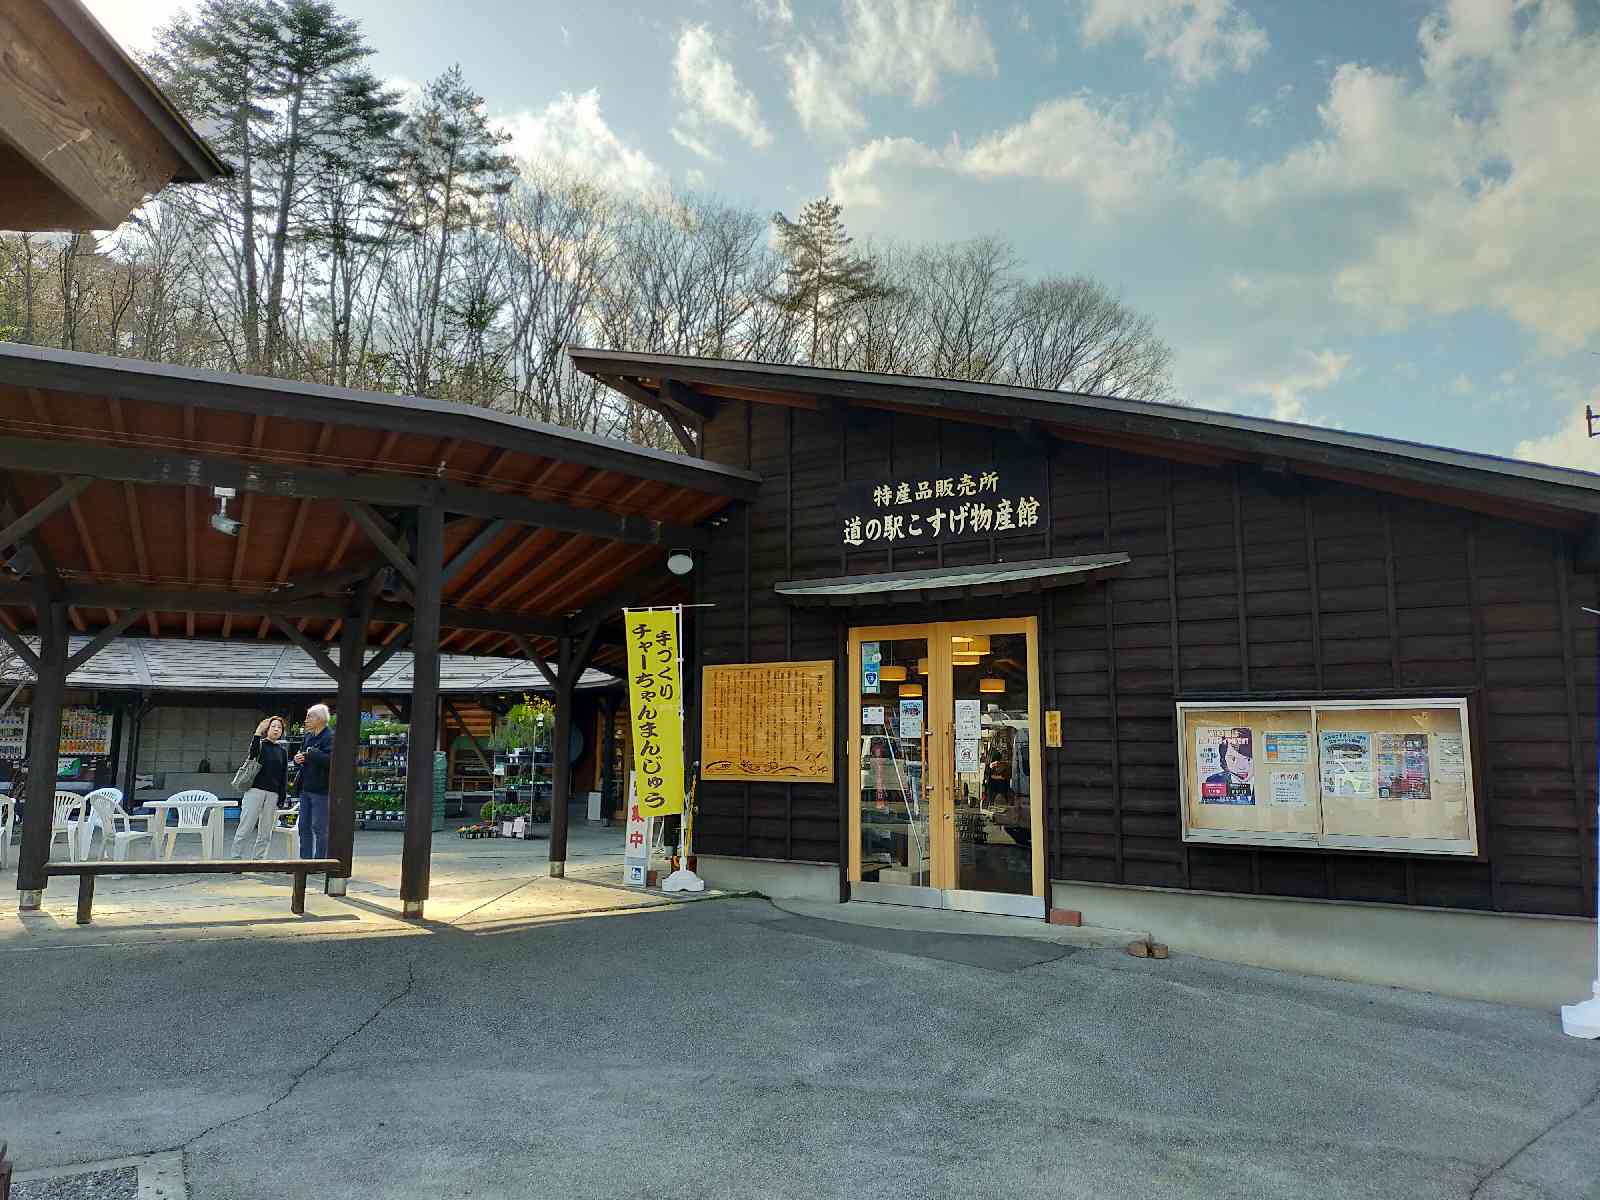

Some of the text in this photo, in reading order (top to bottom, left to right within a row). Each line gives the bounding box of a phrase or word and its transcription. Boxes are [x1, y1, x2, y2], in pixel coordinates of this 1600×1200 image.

[873, 470, 1000, 507] 特産品販売所
[843, 496, 1041, 545] 道の駅こすげ物産館
[655, 630, 674, 700] 手づくり
[632, 623, 666, 809] チャーちゃんまんじゅう
